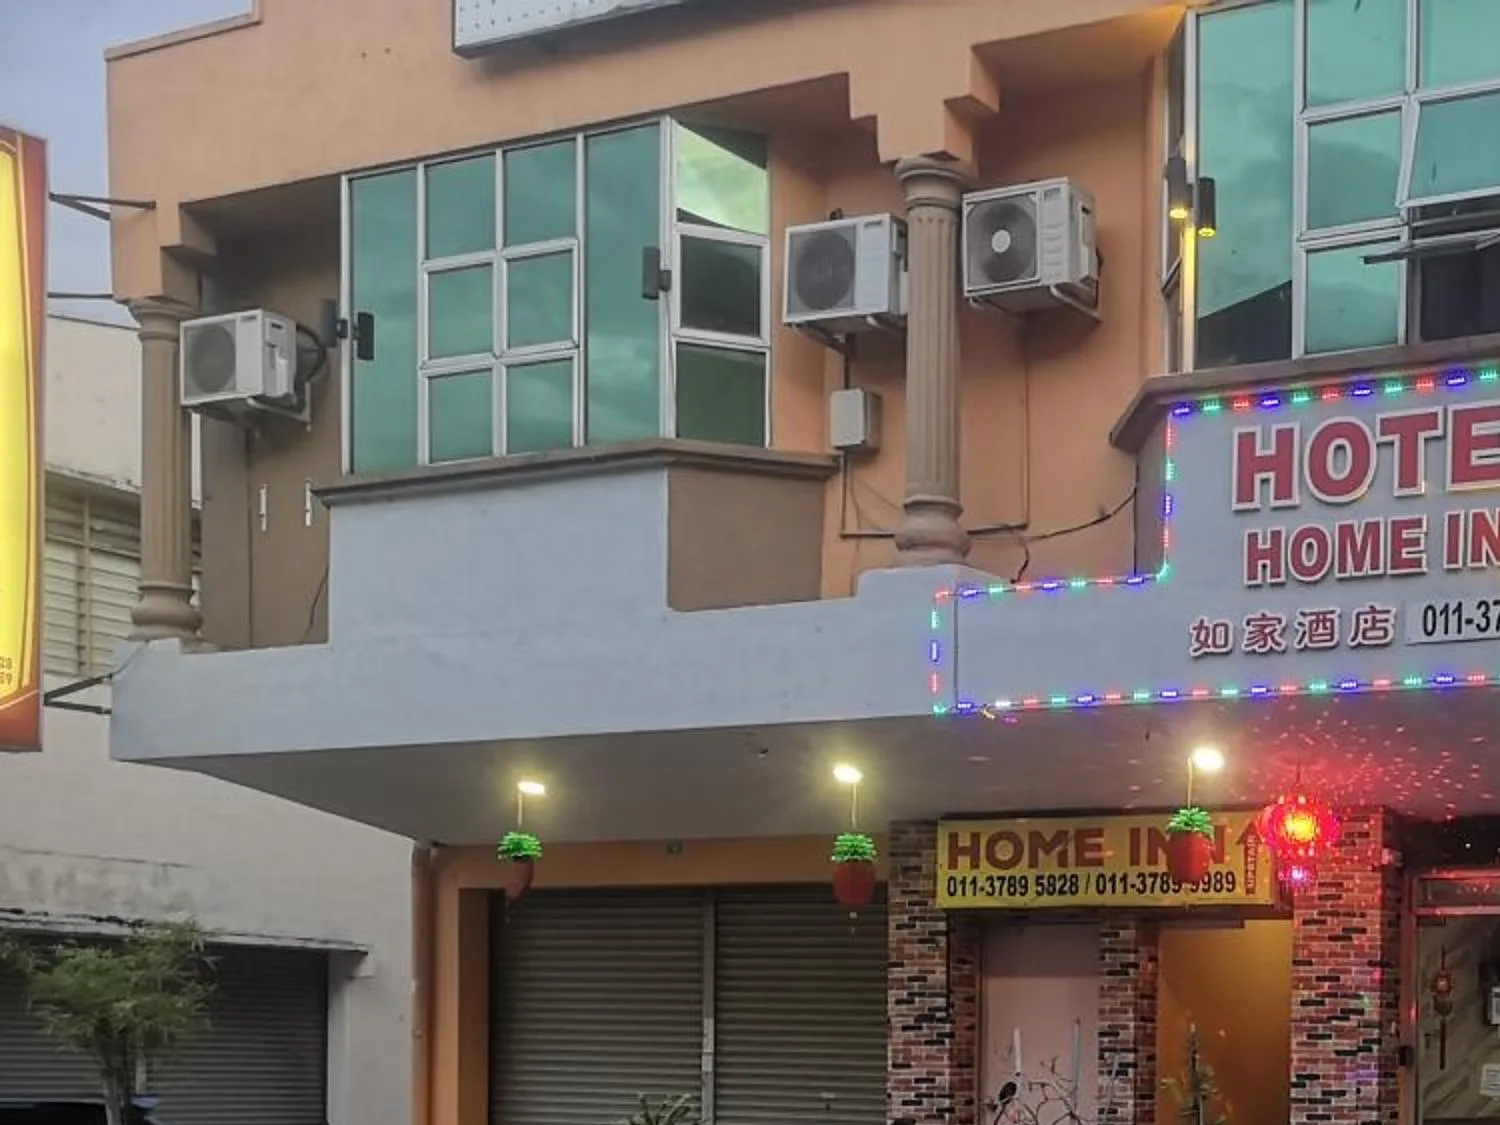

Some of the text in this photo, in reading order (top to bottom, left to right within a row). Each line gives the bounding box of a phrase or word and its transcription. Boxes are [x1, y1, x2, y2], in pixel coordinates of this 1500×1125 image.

[1243, 513, 1428, 587] HOME
[1189, 605, 1398, 659] 如家酒店
[947, 827, 1105, 871] HOME
[947, 875, 1029, 897] 011-3789
[1035, 873, 1080, 896] 5828
